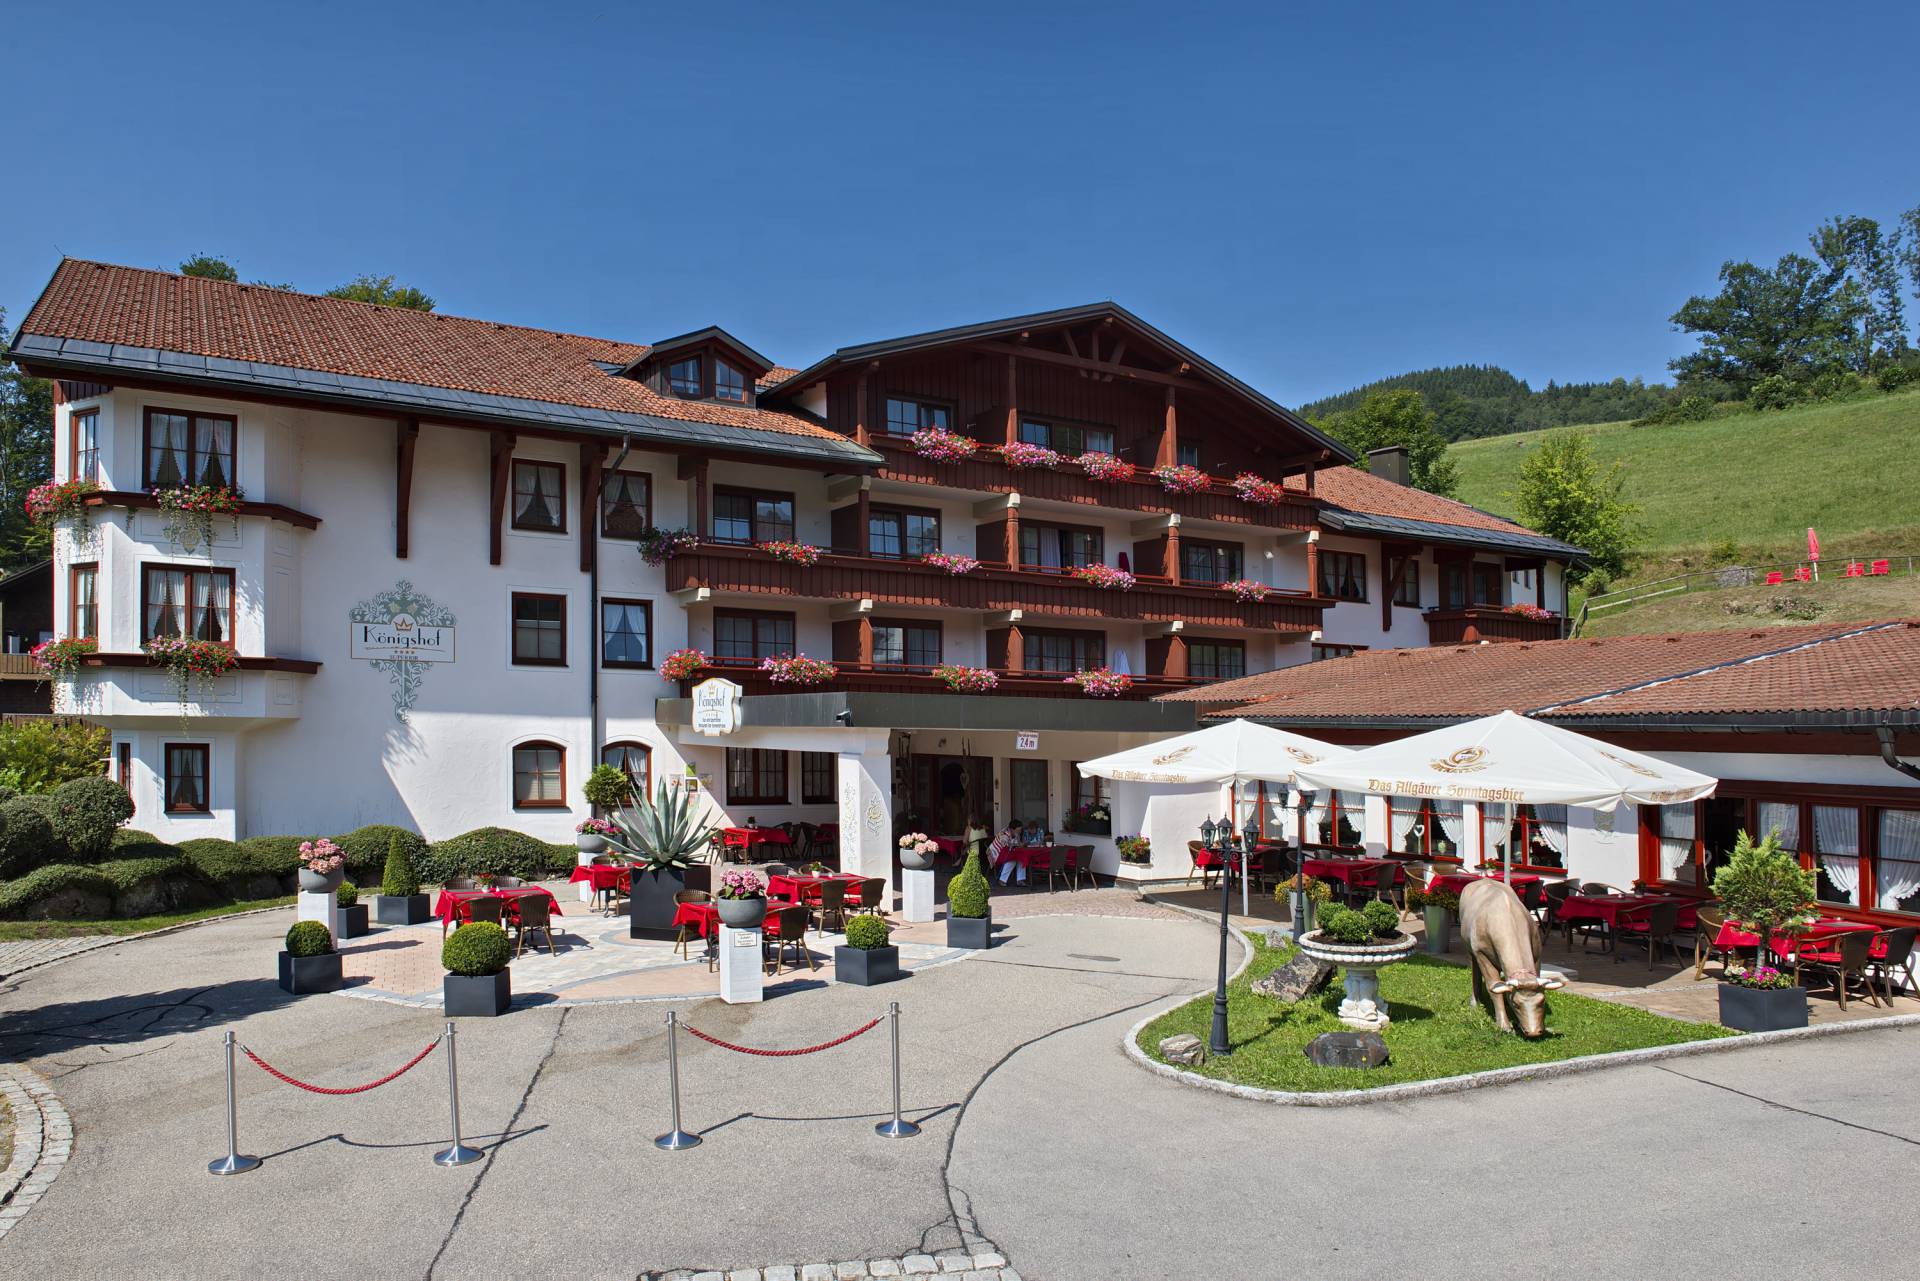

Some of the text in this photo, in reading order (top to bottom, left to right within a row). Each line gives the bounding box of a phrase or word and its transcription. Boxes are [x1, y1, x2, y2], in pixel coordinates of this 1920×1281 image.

[363, 625, 441, 649] Königshof
[1368, 778, 1525, 802] Das Allgäuer Sonntagsbier
